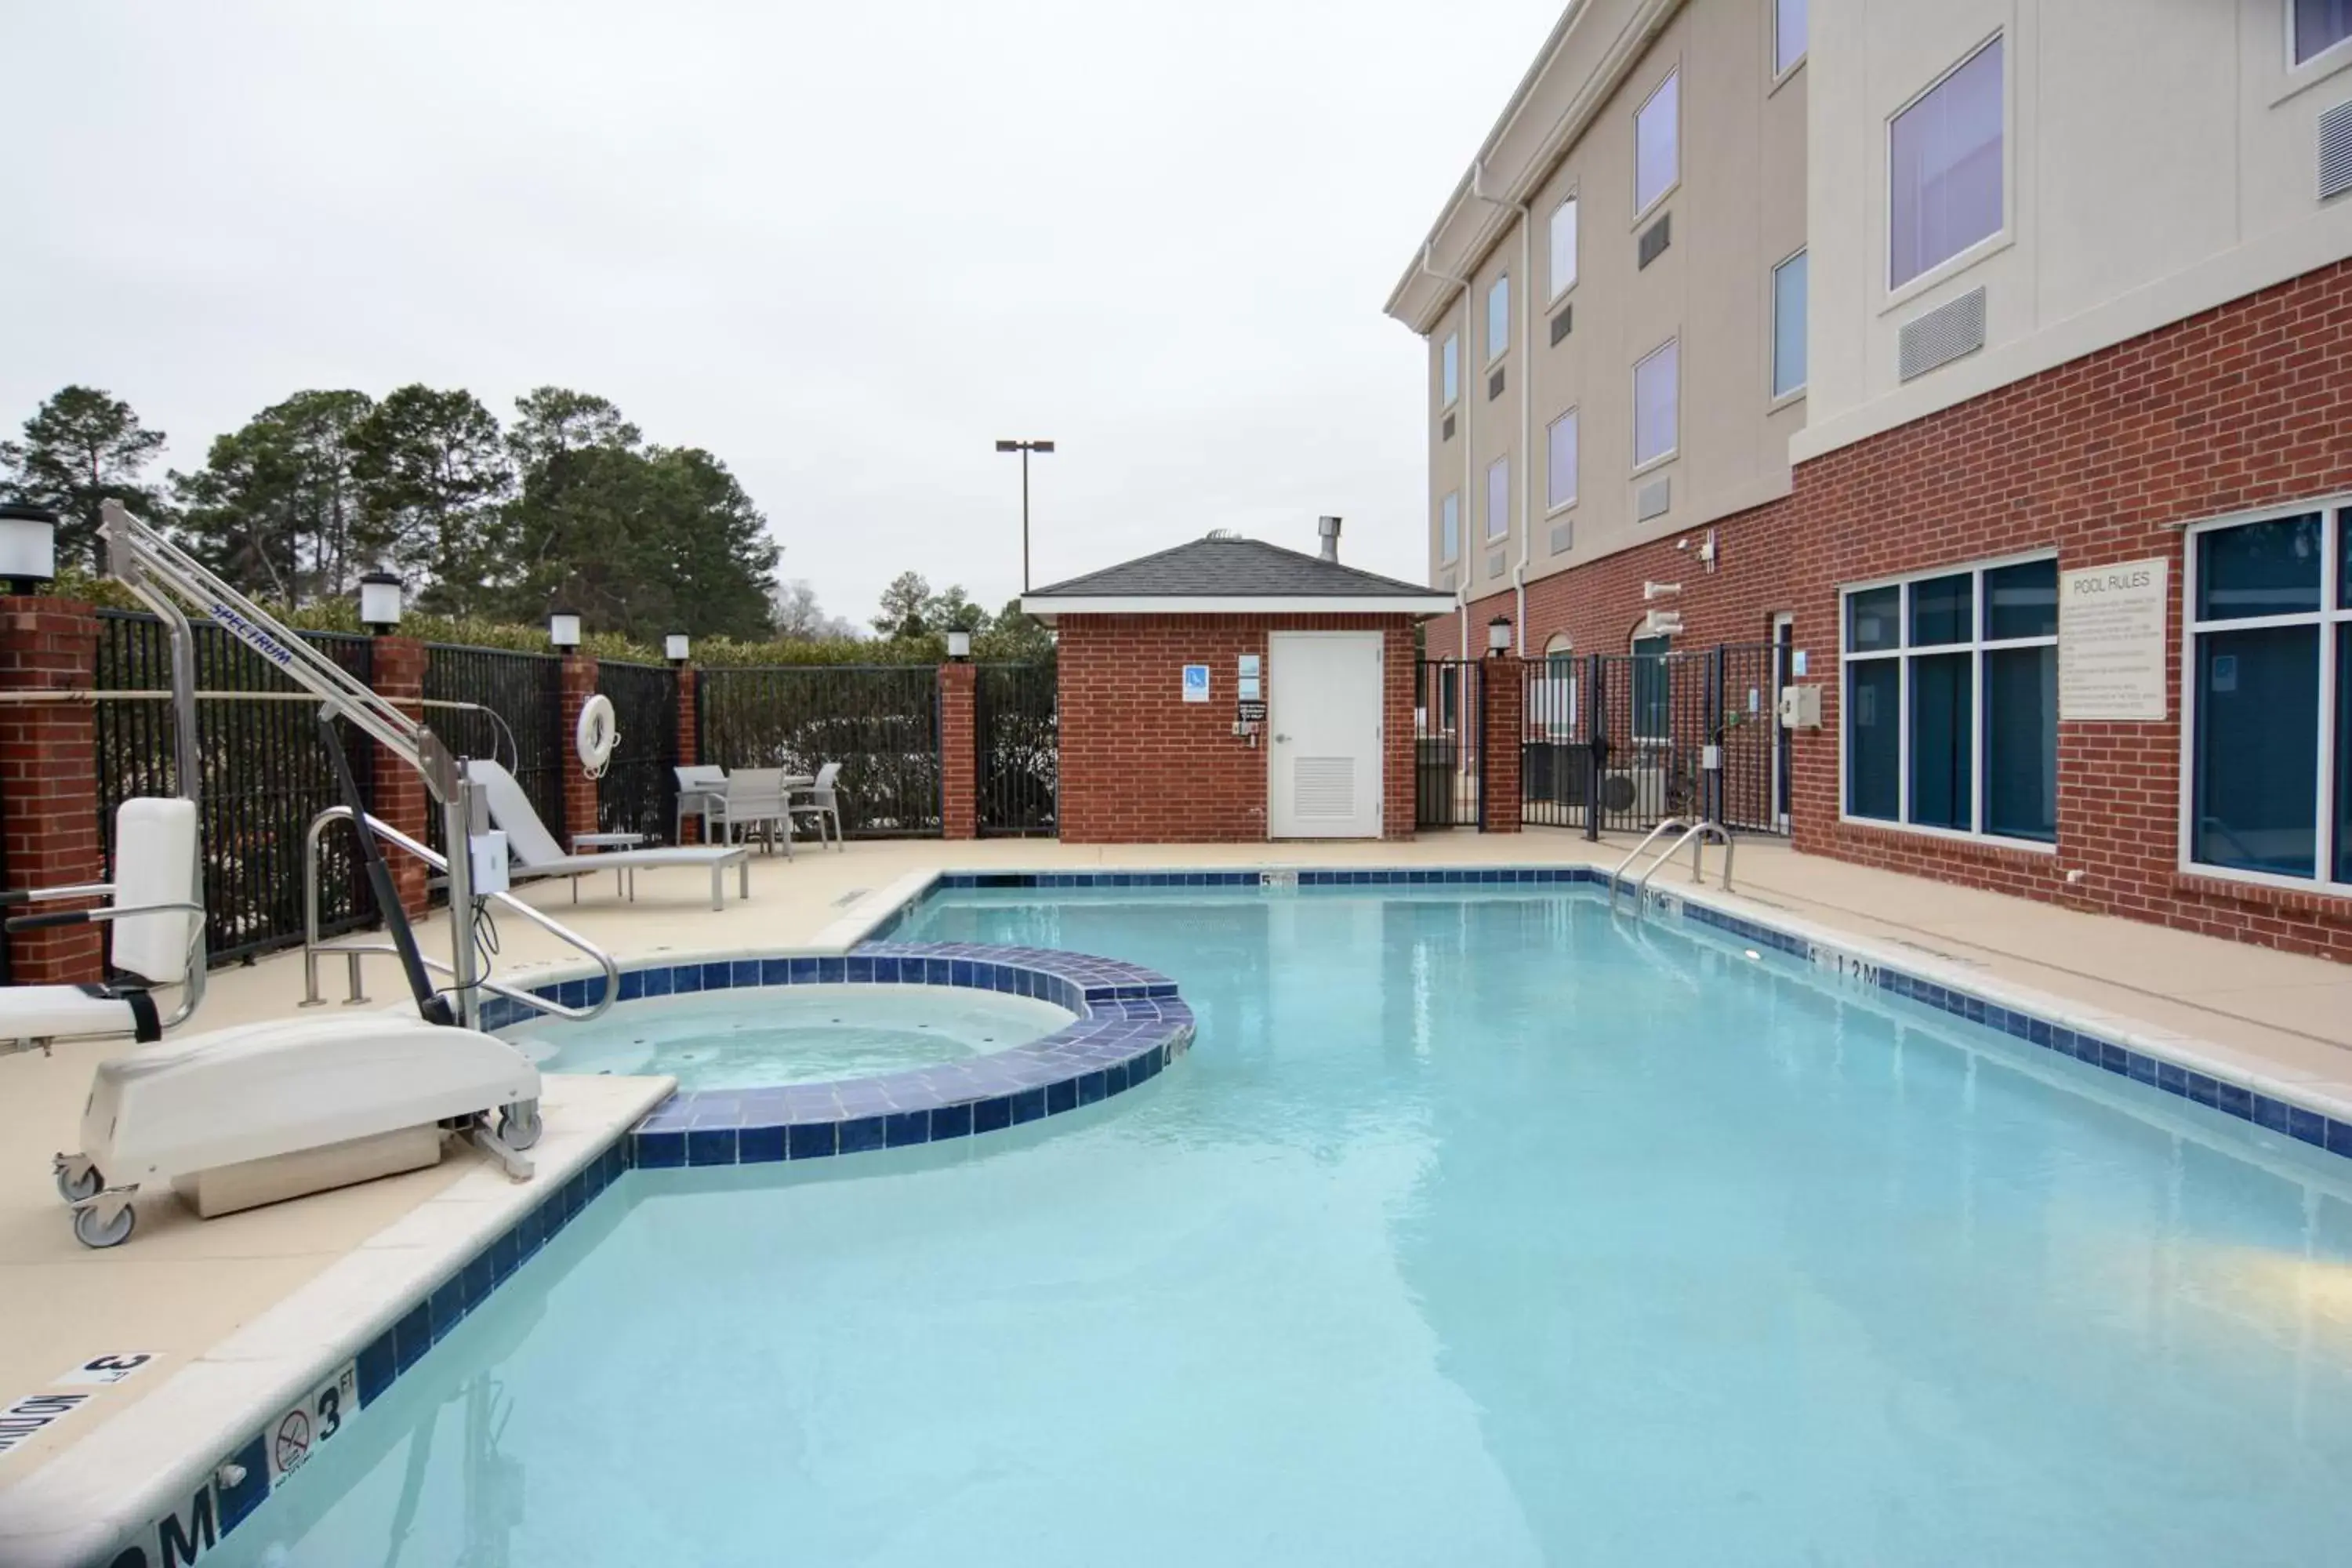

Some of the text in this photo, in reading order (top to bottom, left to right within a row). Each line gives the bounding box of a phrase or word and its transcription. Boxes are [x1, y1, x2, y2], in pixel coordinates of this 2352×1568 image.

[2074, 572, 2150, 594] POOL RULES
[211, 604, 291, 665] SPECTRUM
[84, 1354, 151, 1370] 3
[318, 1367, 354, 1442] 3 FT
